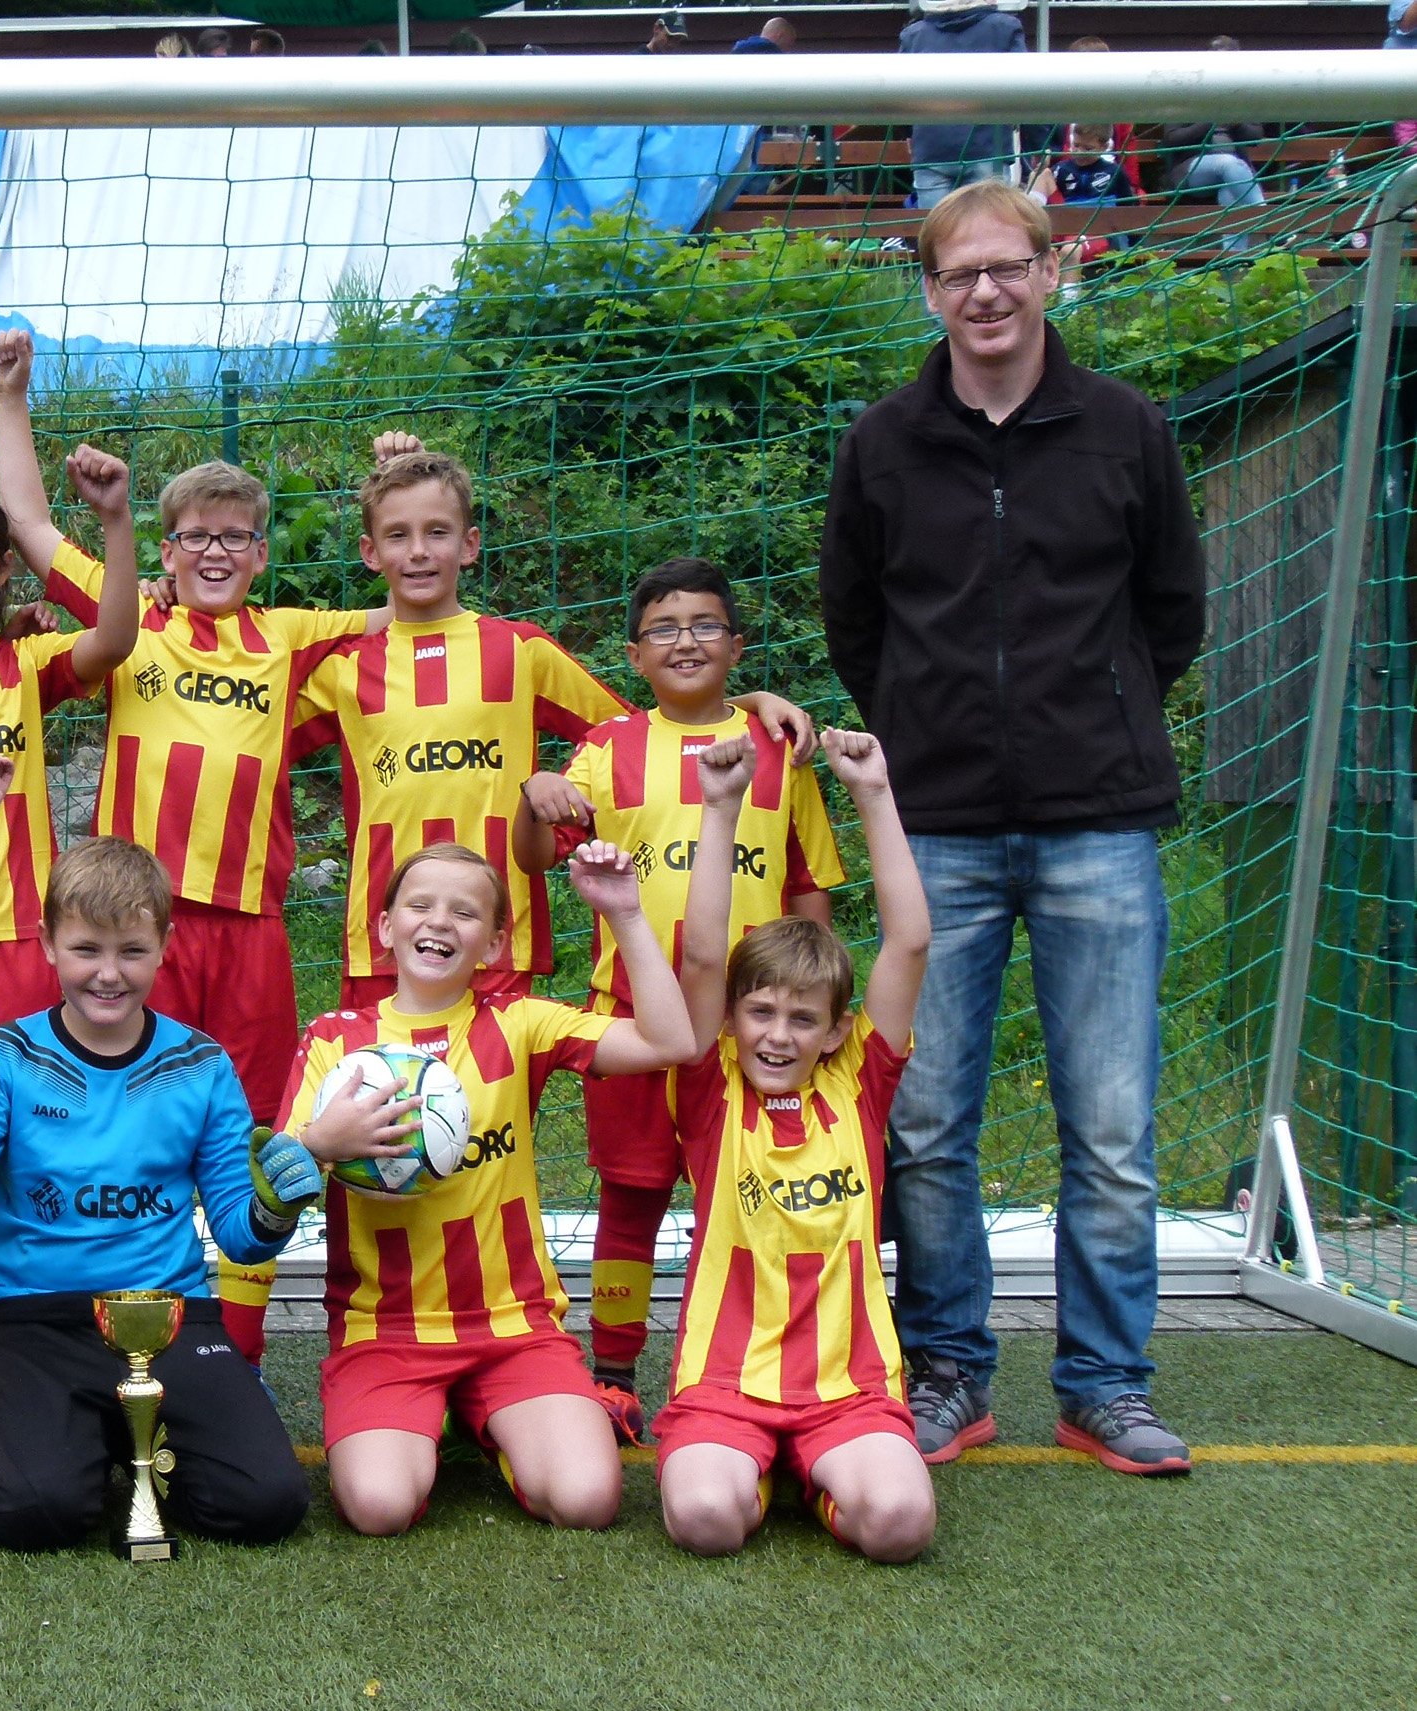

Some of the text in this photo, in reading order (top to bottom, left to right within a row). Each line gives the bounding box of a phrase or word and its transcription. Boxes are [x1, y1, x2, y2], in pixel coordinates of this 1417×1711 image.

[414, 646, 445, 660] JAKO
[174, 671, 270, 714] GEORG
[405, 739, 503, 773] GEORG
[682, 744, 713, 756] JAK
[663, 840, 766, 880] GERG
[32, 1104, 69, 1119] JAKO
[765, 1098, 801, 1110] JAKO
[452, 1121, 516, 1173] ORG
[74, 1184, 174, 1219] GEORG
[768, 1165, 865, 1212] GEORG
[211, 1344, 232, 1353] JAKO
